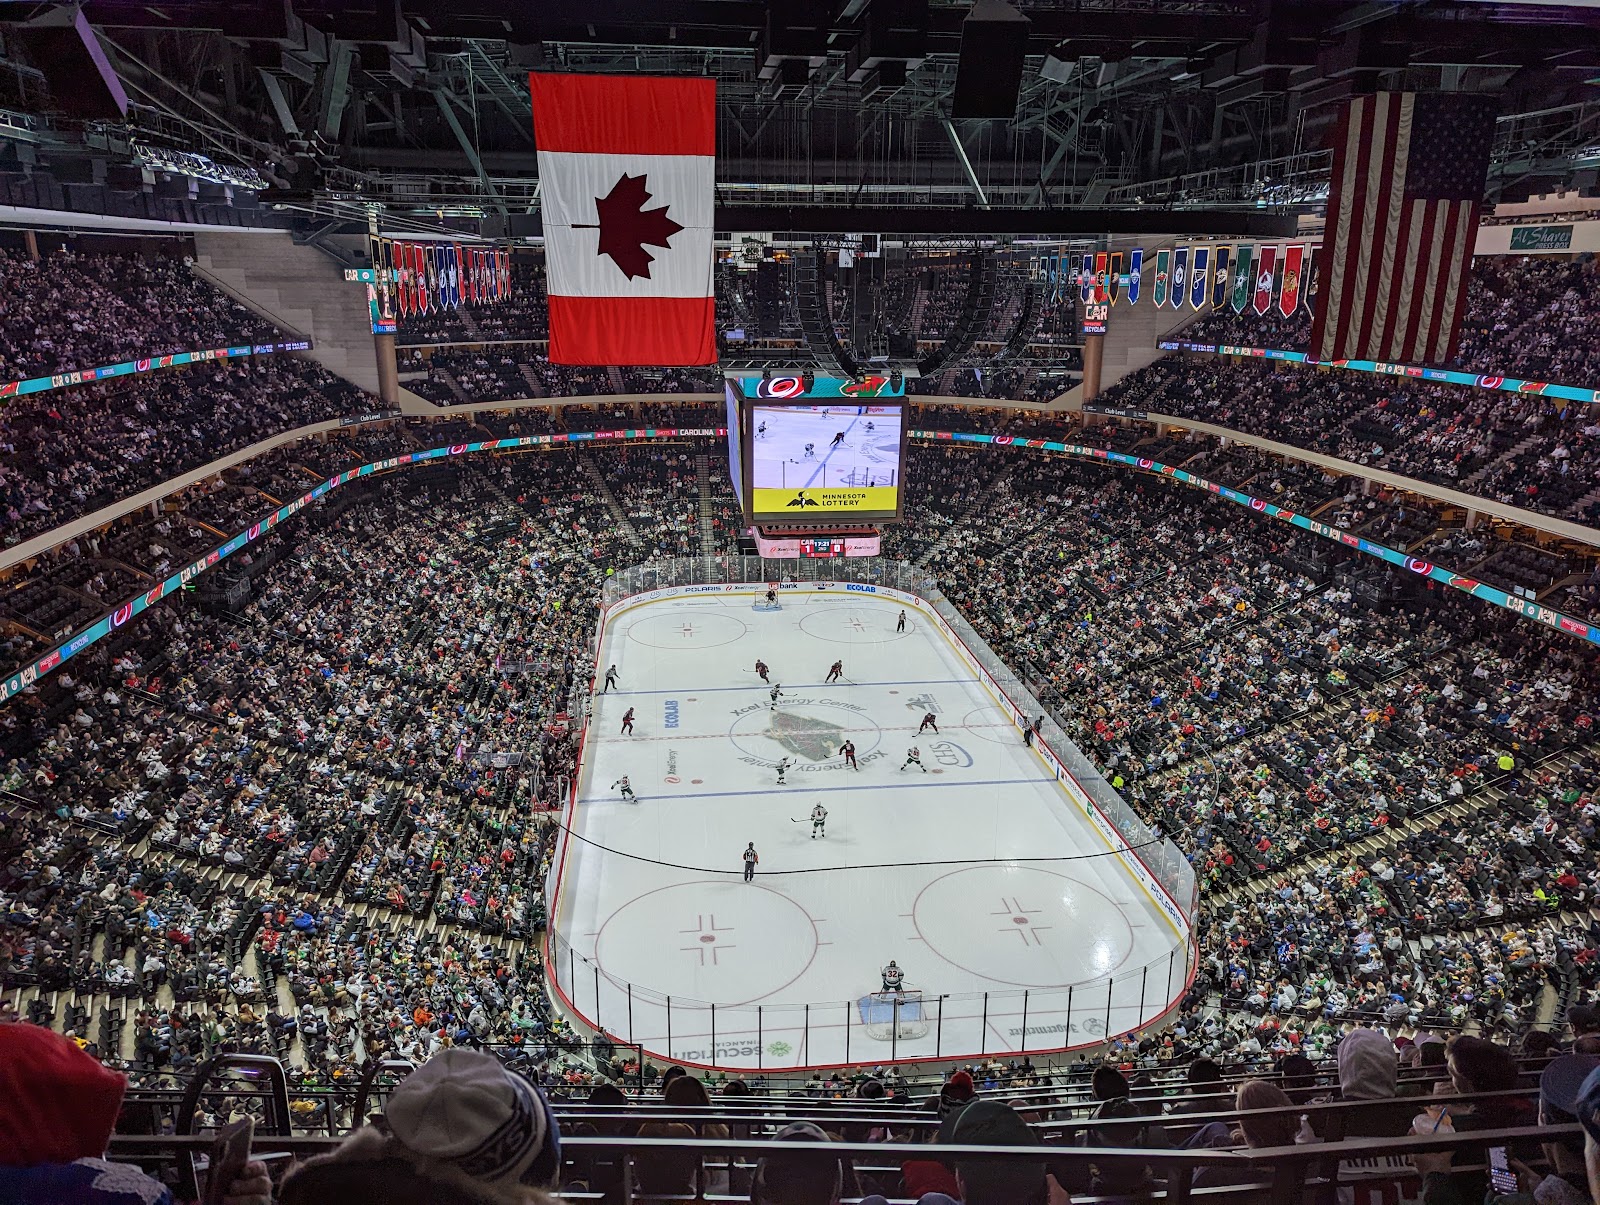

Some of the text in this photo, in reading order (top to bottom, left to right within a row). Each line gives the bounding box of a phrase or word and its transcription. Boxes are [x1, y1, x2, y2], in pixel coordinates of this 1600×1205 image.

[1510, 227, 1571, 246] Al Shaver
[345, 269, 358, 281] CAR
[1085, 305, 1107, 320] CAR
[1375, 362, 1386, 374] CAR
[52, 375, 64, 388] CAR
[370, 413, 381, 421] Level
[1104, 407, 1114, 415] Club
[520, 437, 531, 446] CAR
[822, 499, 860, 507] LOTTERY
[1310, 520, 1322, 534] CAR
[805, 545, 810, 553] 1
[834, 544, 841, 552] 0
[685, 585, 721, 593] POLARIS
[846, 584, 876, 593] ECOLAB
[1505, 595, 1525, 614] CAR
[1537, 607, 1558, 626] MIN
[1562, 617, 1587, 632] PRESENTED
[20, 664, 38, 688] MIN
[664, 700, 679, 728] ECOLAB
[730, 698, 867, 717] Xcel Energy Center
[737, 756, 780, 769] enter
[857, 750, 888, 767] Xcel
[1151, 882, 1182, 928] POLARIS
[888, 970, 898, 978] 32
[673, 1044, 764, 1062] securian
